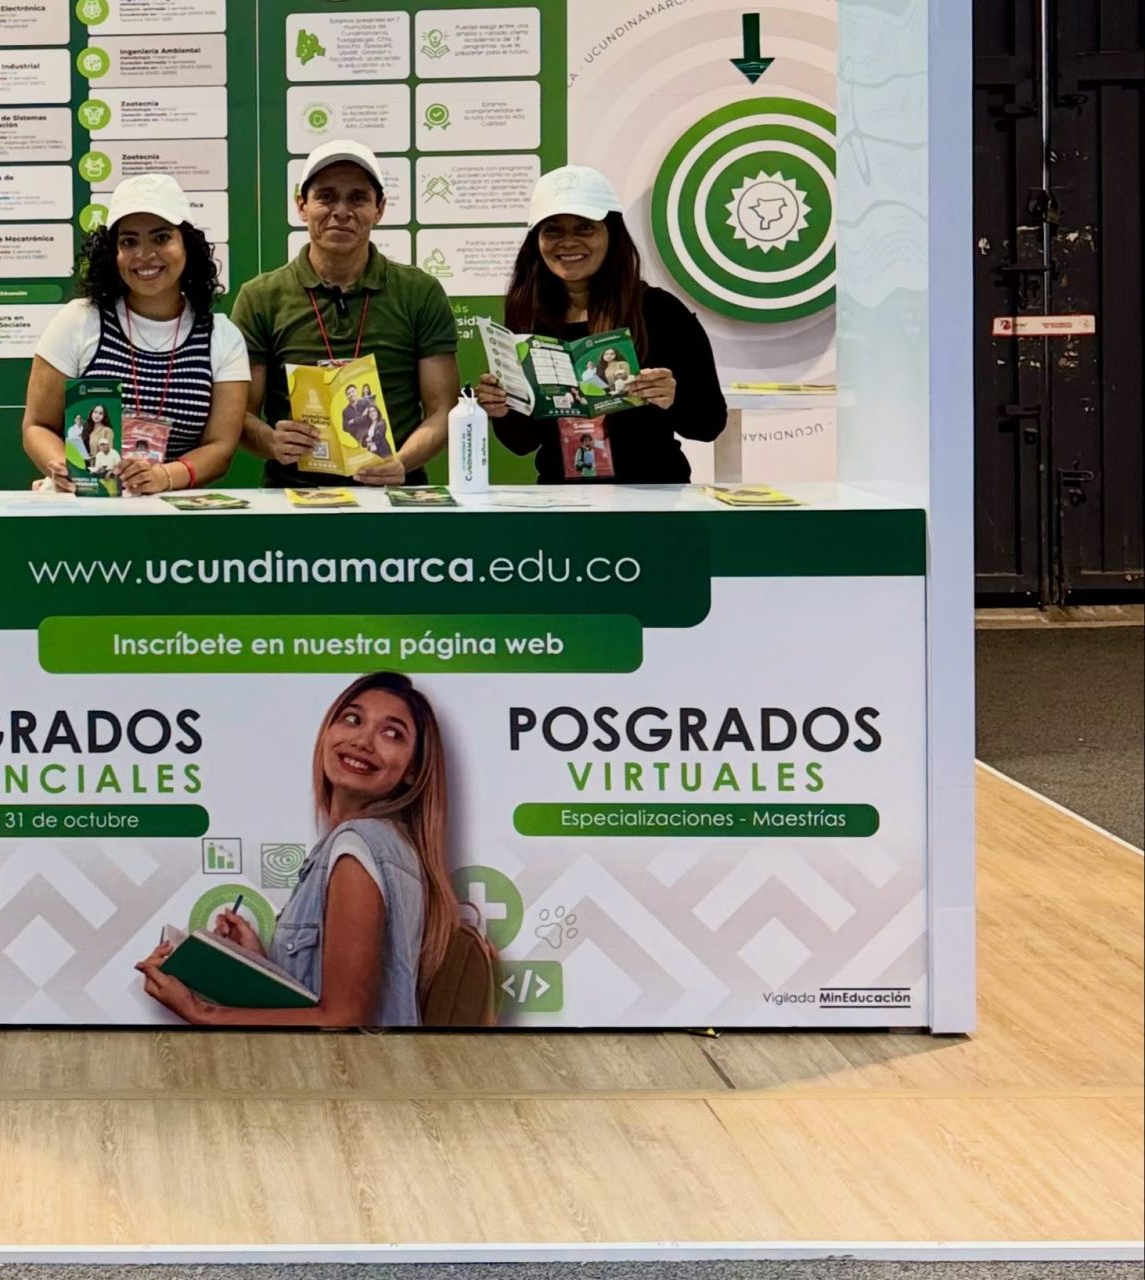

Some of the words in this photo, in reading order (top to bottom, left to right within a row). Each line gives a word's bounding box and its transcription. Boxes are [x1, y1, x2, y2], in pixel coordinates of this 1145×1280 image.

[0, 4, 46, 12] Electrónica
[29, 549, 641, 585] www.ucundinamarca.edu.co
[113, 631, 243, 656] Inscríbete
[251, 637, 284, 655] en
[294, 634, 392, 655] nuestra
[400, 629, 497, 661] página
[504, 631, 565, 655] web
[509, 706, 882, 753] POSGRADOS
[567, 762, 825, 792] VIRTUALES
[4, 813, 25, 828] 31
[32, 812, 57, 828] de
[64, 812, 139, 829] octubre
[561, 809, 734, 831] Especializaciones
[753, 809, 846, 827] Maestrías
[763, 991, 816, 1006] Vigilada
[820, 990, 911, 1004] MinEducación
